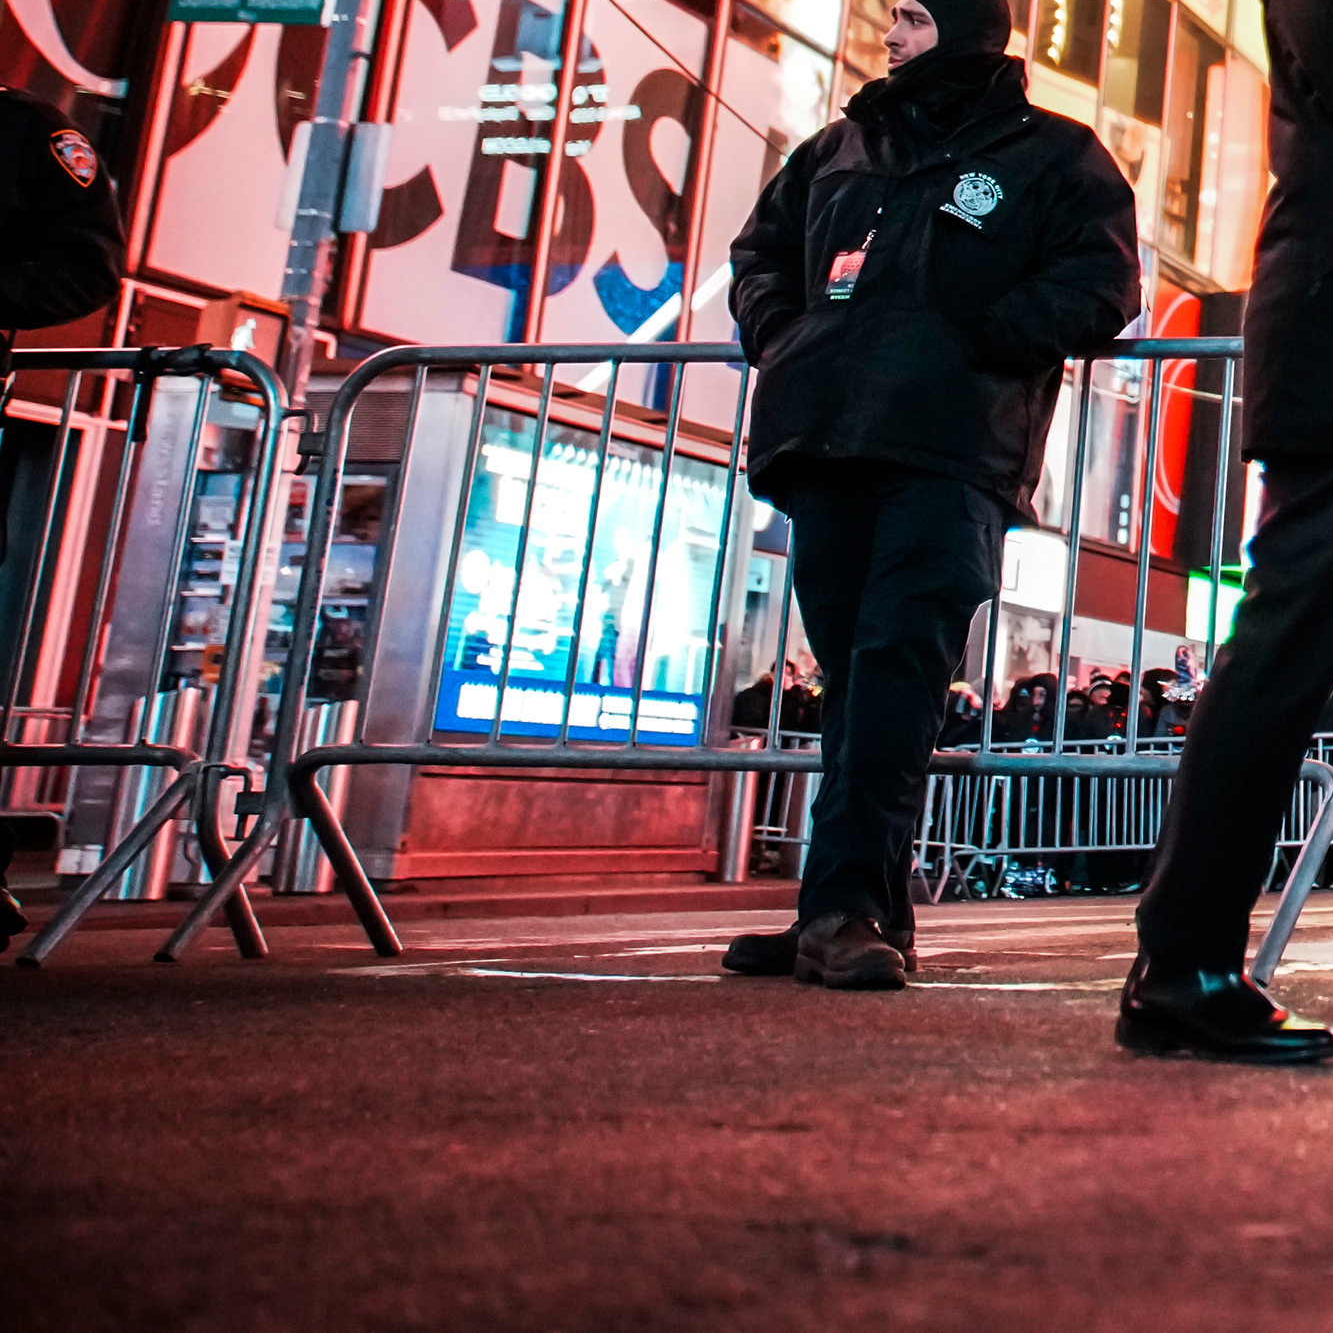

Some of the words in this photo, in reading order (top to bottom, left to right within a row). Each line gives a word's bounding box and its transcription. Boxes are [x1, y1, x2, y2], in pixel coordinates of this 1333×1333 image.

[958, 172, 976, 180] NEW
[977, 172, 997, 184] YORK
[994, 184, 1004, 200] CITY
